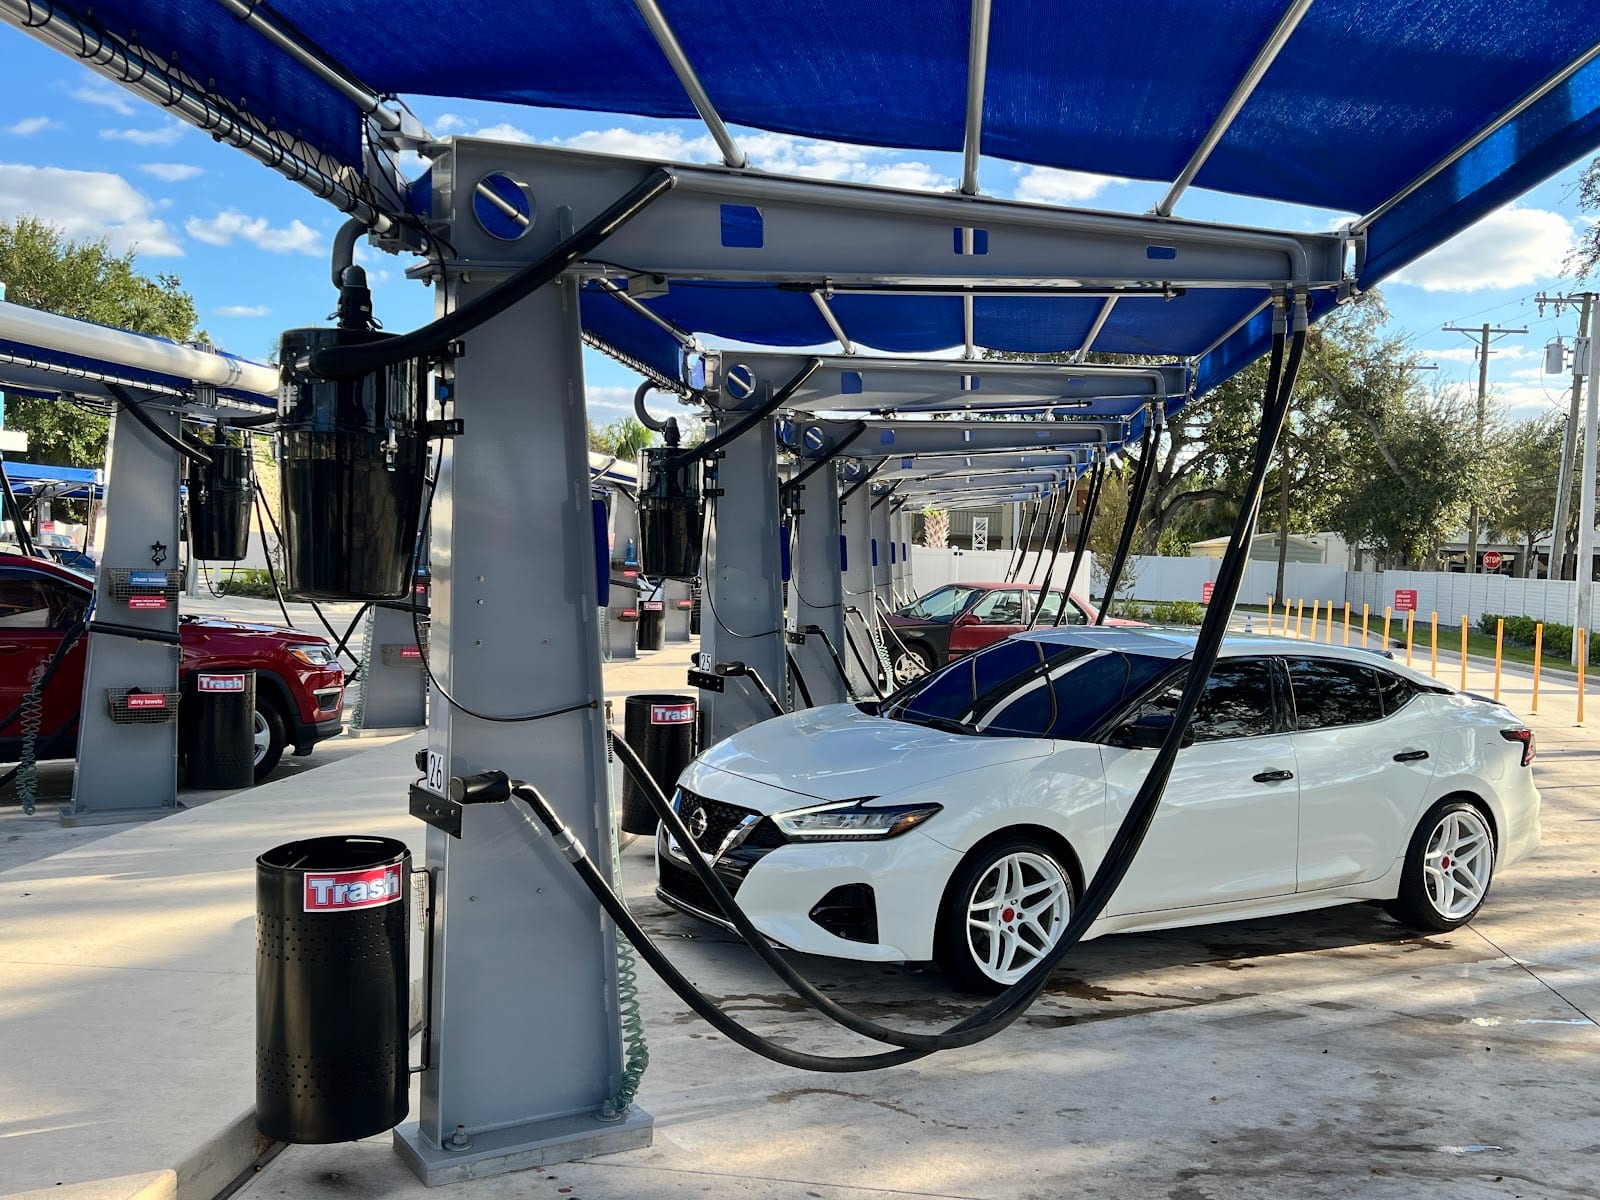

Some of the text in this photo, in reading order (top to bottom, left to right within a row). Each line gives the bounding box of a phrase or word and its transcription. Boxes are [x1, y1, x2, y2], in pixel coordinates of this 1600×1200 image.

[1485, 556, 1501, 564] STOP
[701, 654, 711, 672] 25
[200, 676, 242, 690] Trash
[653, 706, 695, 721] Trash
[428, 753, 443, 790] 26
[309, 869, 400, 906] Trash
